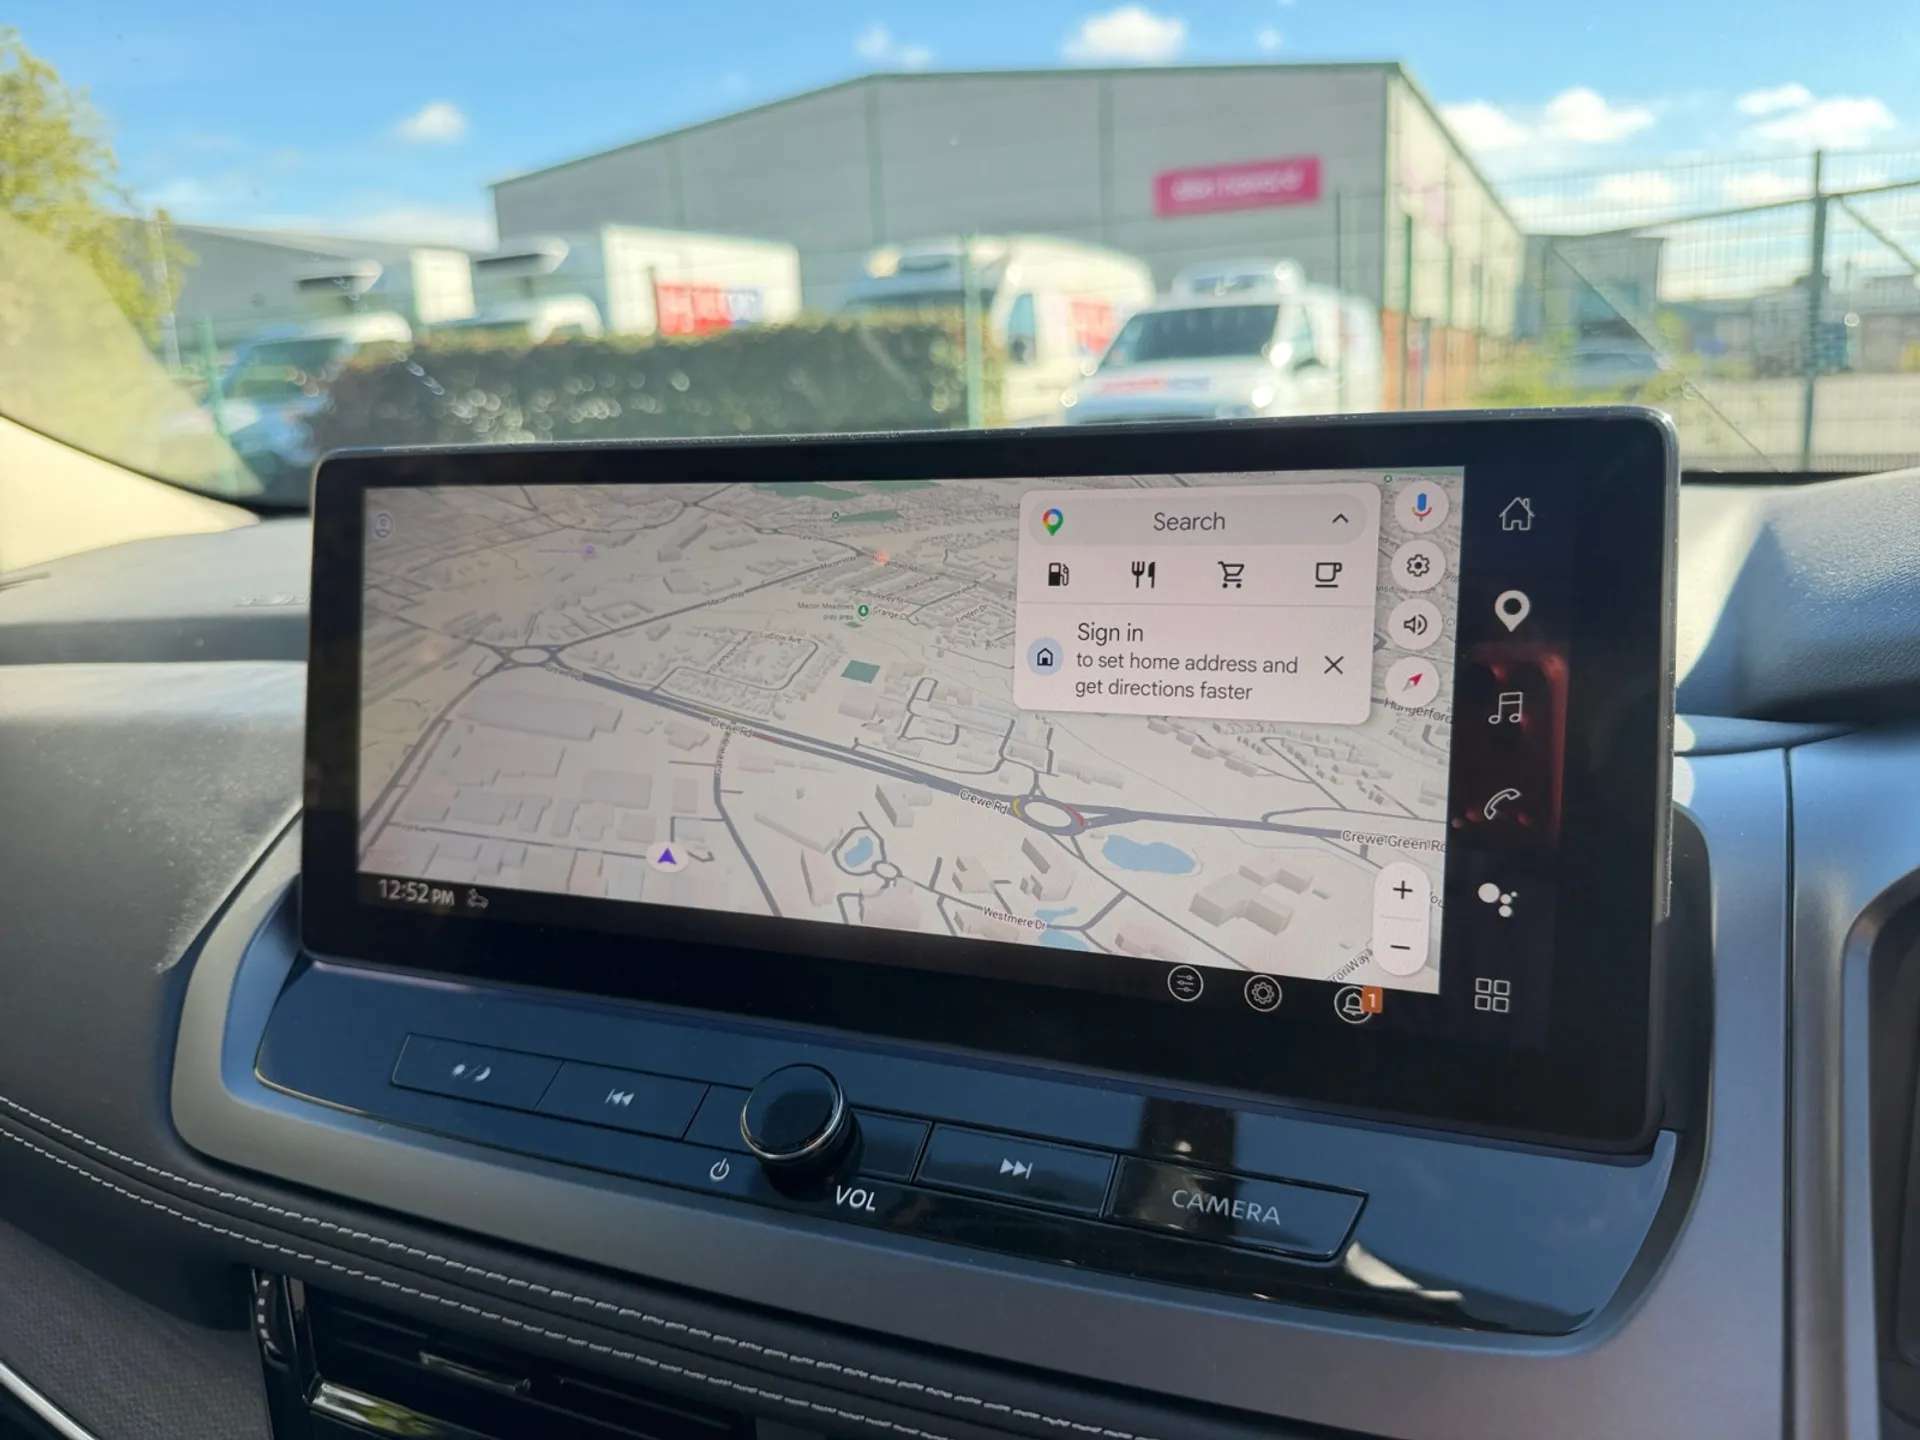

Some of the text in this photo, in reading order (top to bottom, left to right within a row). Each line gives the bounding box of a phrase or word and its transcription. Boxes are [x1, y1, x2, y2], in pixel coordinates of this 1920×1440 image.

[1152, 511, 1226, 531] Search
[1077, 622, 1144, 646] Sign in
[1076, 652, 1299, 674] to set home address and
[1075, 679, 1253, 700] get directions faster
[711, 717, 753, 738] Crewe Rd
[959, 789, 1008, 815] Crewe Rd
[1342, 830, 1385, 845] Crewe
[1387, 835, 1429, 850] Green
[377, 878, 455, 906] 12:52 PM
[982, 906, 1046, 930] Westmere Dr
[1346, 950, 1371, 971] Way
[1367, 993, 1376, 1008] 1
[834, 1184, 877, 1212] VOL
[1170, 1188, 1282, 1226] CAMERA
